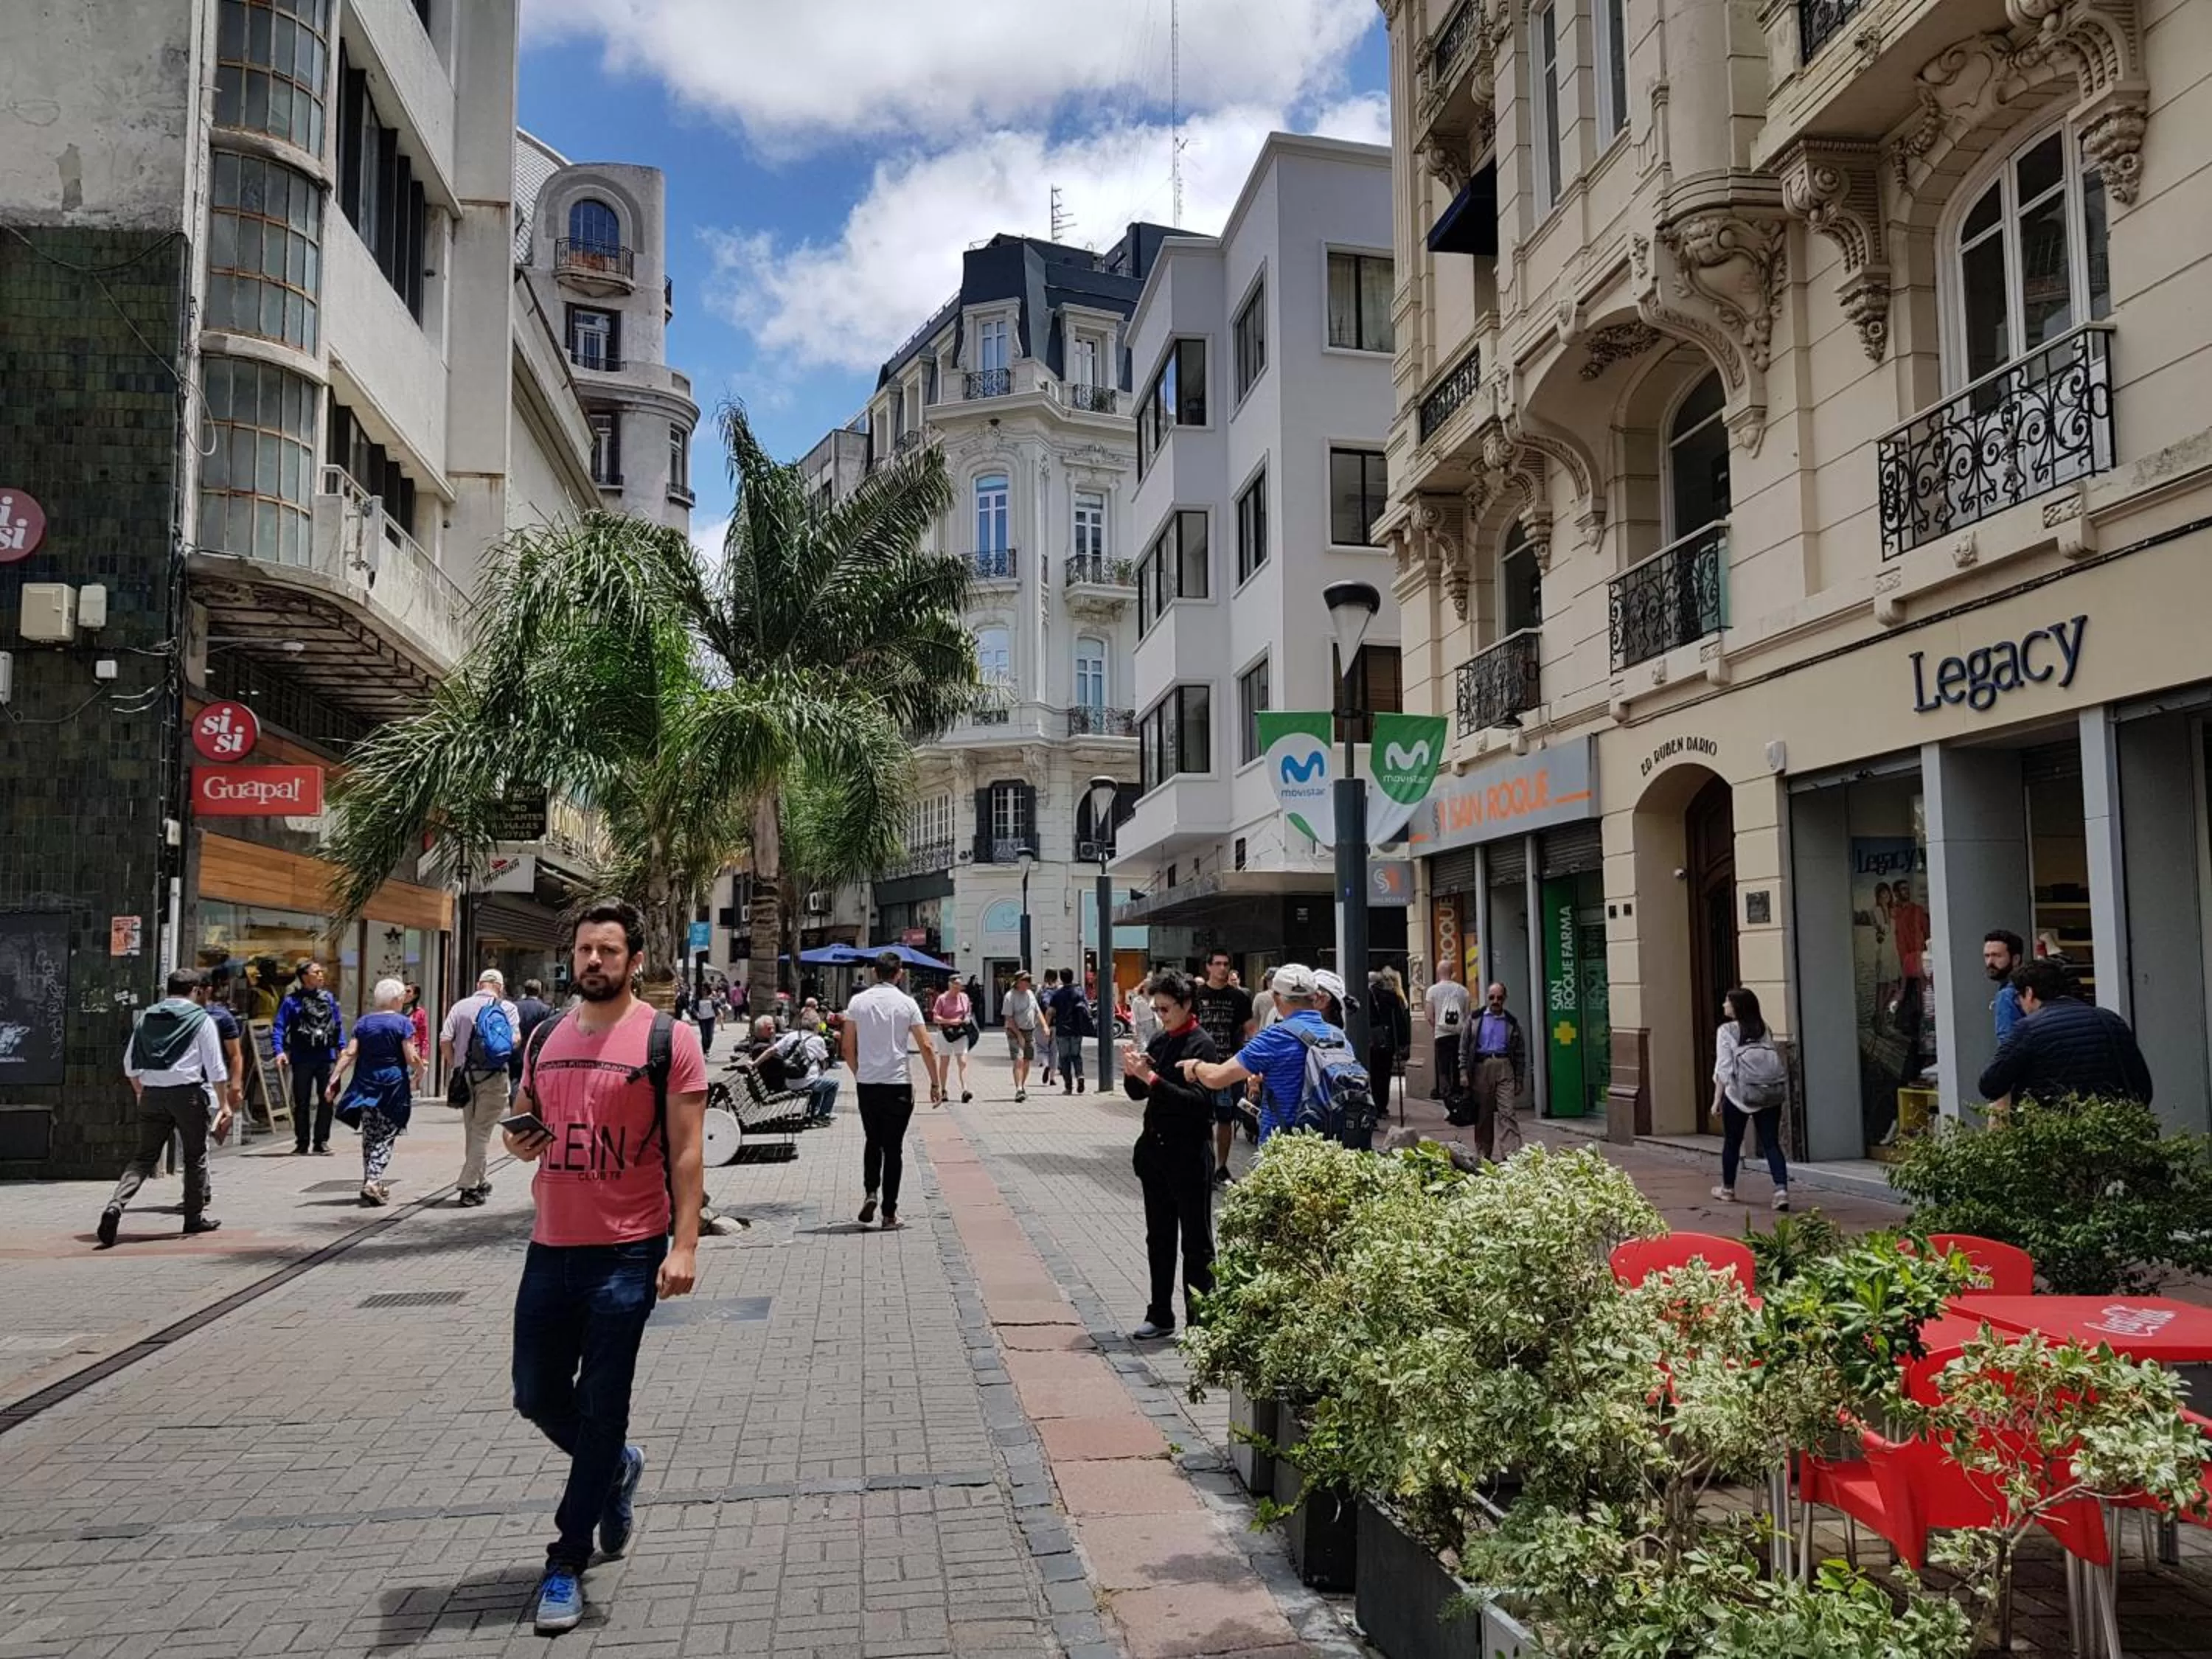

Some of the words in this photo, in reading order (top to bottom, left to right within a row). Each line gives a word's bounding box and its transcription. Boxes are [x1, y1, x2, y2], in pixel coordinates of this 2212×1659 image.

[1908, 614, 2089, 713] Legacy
[201, 707, 232, 735] si
[213, 726, 245, 753] si
[1654, 737, 1683, 764] RUBEN
[1686, 737, 1717, 757] DARIO
[203, 776, 301, 804] Guapa!
[1280, 787, 1326, 798] movistar
[1382, 774, 1428, 784] movistar
[1486, 768, 1549, 821] ROQUE
[1559, 905, 1573, 958] FARMA
[1551, 980, 1564, 1010] SAN
[1561, 960, 1576, 1010] ROQUE
